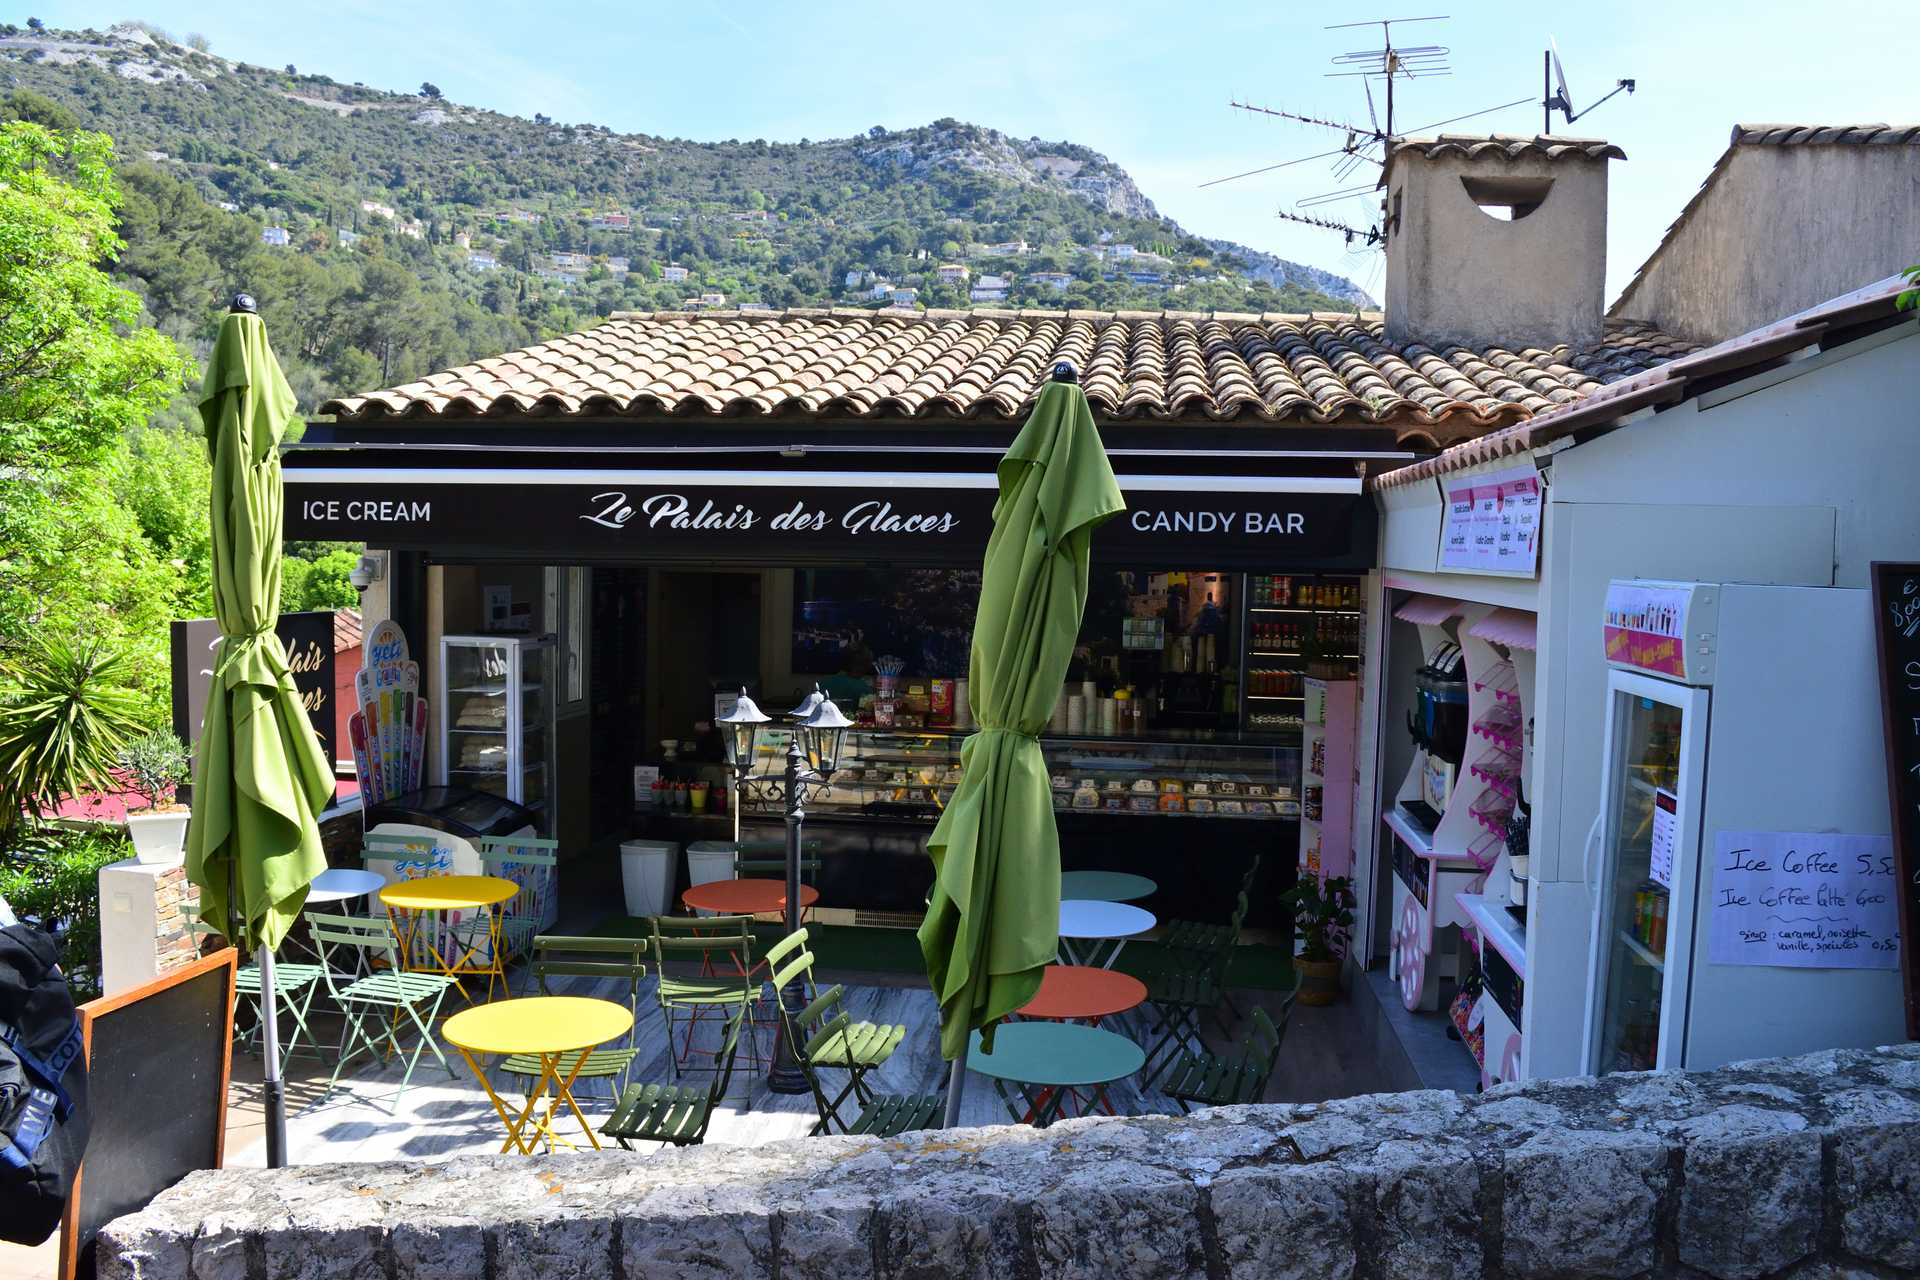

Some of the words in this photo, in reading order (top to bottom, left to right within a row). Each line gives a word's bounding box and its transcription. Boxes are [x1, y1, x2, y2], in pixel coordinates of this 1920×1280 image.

[303, 501, 340, 520] ICE
[346, 501, 431, 521] CREAM
[579, 492, 637, 529] Le
[641, 494, 760, 530] Palais
[770, 501, 833, 532] des
[841, 502, 961, 534] Glaces
[1131, 510, 1236, 533] CANDY
[1245, 512, 1305, 534] BAR
[286, 637, 326, 673] lais
[1724, 849, 1772, 871] Ice
[1782, 850, 1840, 874] Coffee
[1719, 888, 1752, 907] Ice
[1758, 886, 1815, 907] Coffee
